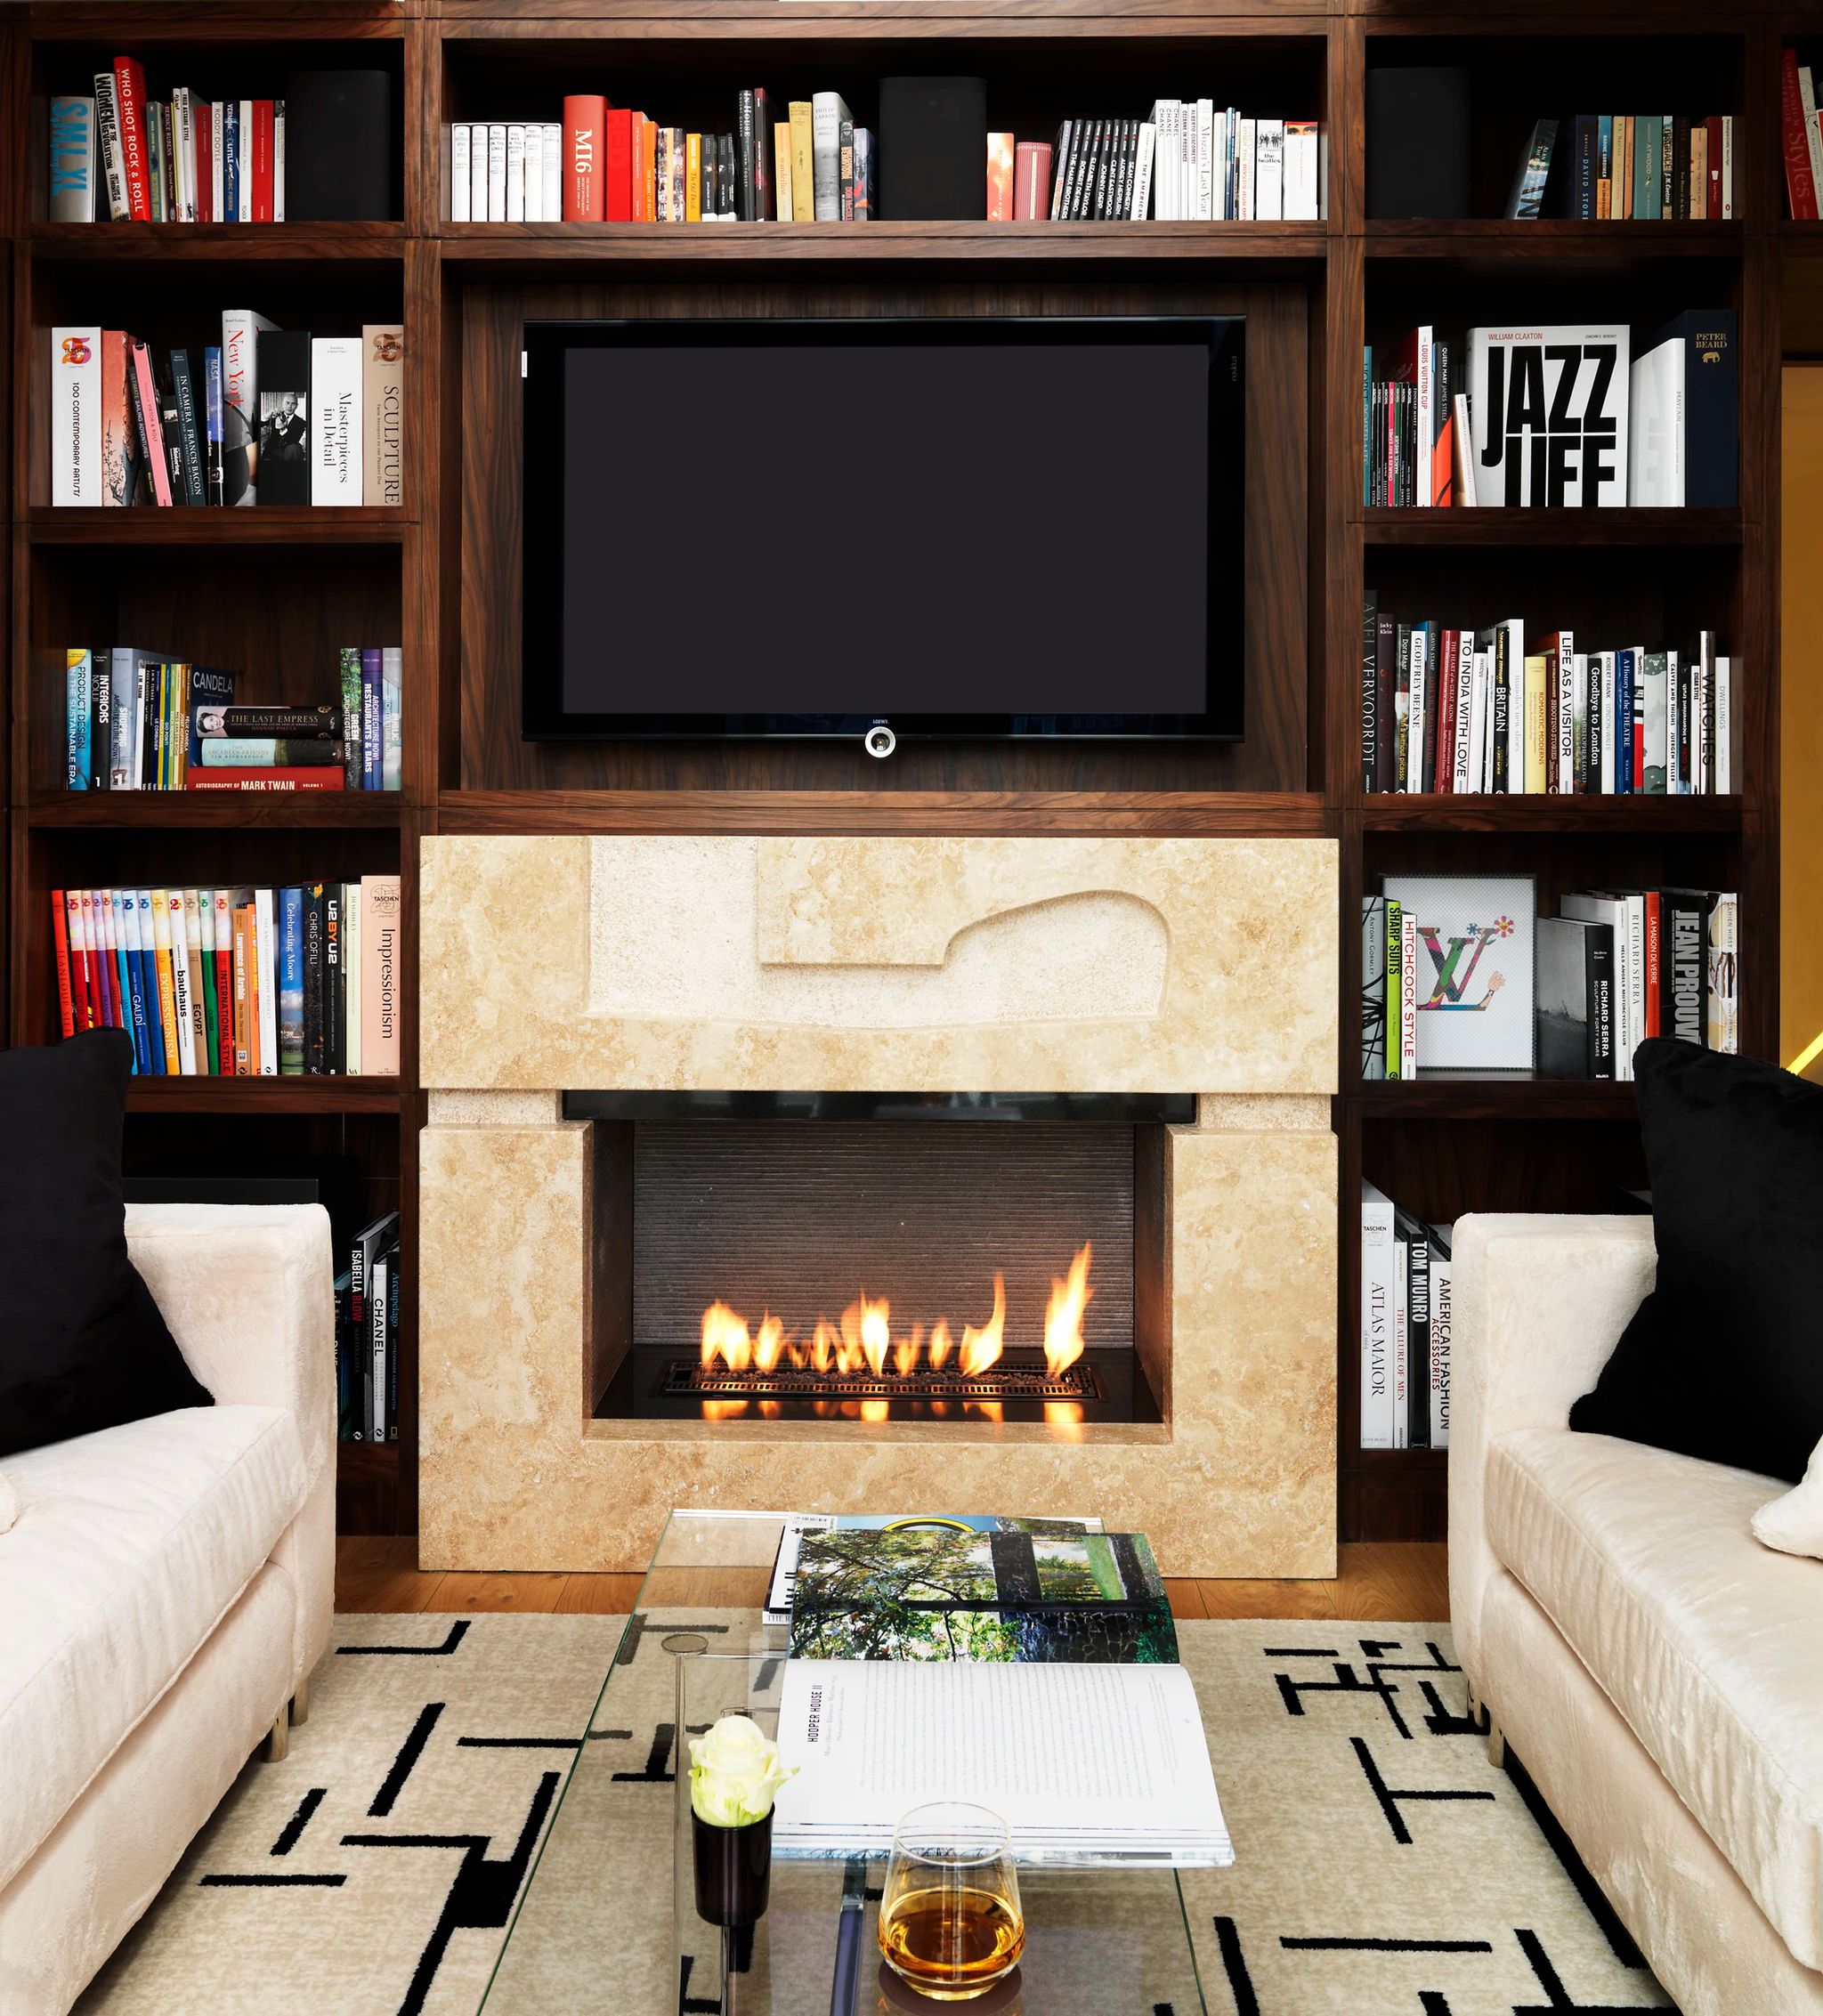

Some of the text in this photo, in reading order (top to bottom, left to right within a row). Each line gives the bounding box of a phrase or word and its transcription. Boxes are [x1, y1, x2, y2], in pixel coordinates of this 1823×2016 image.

[95, 76, 114, 124] WOMEN
[121, 69, 130, 96] WHO
[125, 101, 135, 132] SHOT
[743, 106, 752, 137] HOUSE
[101, 125, 113, 169] REVOLUTION
[127, 135, 139, 167] ROCK
[575, 129, 592, 173] MI6
[1200, 126, 1211, 167] Mozart's
[1664, 129, 1672, 203] DISGRACE Coetzee
[1788, 133, 1811, 198] Styles
[133, 182, 143, 212] ROLL
[779, 157, 787, 195] wanderlust
[1081, 157, 1097, 215] ELIZABETH TAYLOR
[1097, 163, 1108, 209] JOHNNY DEPP
[1106, 179, 1115, 216] EASTWOOD
[1115, 158, 1126, 215] AUDREY HEPBURN
[1124, 179, 1133, 211] CONNERY
[1200, 192, 1211, 215] Year
[1487, 333, 1514, 341] WILLIAM
[1695, 333, 1727, 341] PETER
[1695, 341, 1728, 349] BEARD
[228, 329, 245, 409] New York
[131, 374, 150, 458] ULTIMATE SAILING ADVENTURES
[1481, 344, 1617, 467] JAZZ
[72, 383, 80, 498] 100 CONTEMPORARY ARTISTS
[173, 447, 181, 475] Motoring
[180, 376, 202, 496] IN CAMERA FRANCIS BACON
[324, 409, 336, 466] in Detail
[336, 393, 352, 483] Masterpieces
[383, 385, 400, 504] SCULPTURE
[69, 668, 77, 676] IN
[193, 672, 234, 694] CANDELA
[1412, 637, 1422, 728] GEOFFREY BEENE
[1562, 637, 1571, 757] LIFE AS A VISITOR
[78, 667, 86, 749] PRODUCT DESIGN
[100, 675, 109, 723] INTERIORS
[231, 715, 319, 723] THE LAST EMPRESS
[364, 684, 372, 740] RESTAURANTS
[1363, 654, 1374, 765] VERVOORDT
[1456, 638, 1472, 777] TO INDIA WITH LOVE
[1496, 687, 1506, 732] BRITAIN
[1590, 668, 1600, 765] Goodbye to London
[1702, 672, 1715, 766] WATCHES
[69, 700, 77, 763] SUSTAINABLE
[119, 708, 128, 747] SHOPPING
[351, 714, 359, 741] GREEN
[69, 765, 77, 784] ERA
[241, 781, 268, 790] MARK
[269, 781, 296, 790] TWAIN
[364, 750, 372, 773] BARS
[286, 903, 296, 980] Celebrating Moore
[309, 911, 318, 965] CHRIS OFILI
[1389, 908, 1400, 975] SHARP SUITS
[1651, 917, 1657, 925] LA
[1675, 910, 1700, 960] JEAN
[377, 928, 396, 1039] Impressionism
[1632, 914, 1640, 1005] RICHARD SERRA
[1651, 953, 1657, 962] DE
[133, 995, 146, 1025] GAUDÍ
[177, 970, 188, 1017] bauhaus
[1405, 921, 1414, 1057] HITCHCOCK STYLE
[159, 973, 174, 1058] EXPRESSIONISM
[193, 1004, 203, 1036] EGYPT
[220, 969, 231, 1072] INTERNATIONAL STYLE
[1600, 980, 1609, 1057] RICHARD SERRA
[352, 1250, 362, 1322] ISABELLA BLOW
[390, 1273, 400, 1327] Archipelago
[1412, 1241, 1428, 1323] TOM MUNRO
[374, 1298, 383, 1356] CHANEL
[1371, 1282, 1385, 1397] ATLAS MAIOR
[1432, 1317, 1440, 1390] ACCESSORIES
[810, 1691, 822, 1712] HOUSE
[807, 1714, 820, 1742] HOOPER
